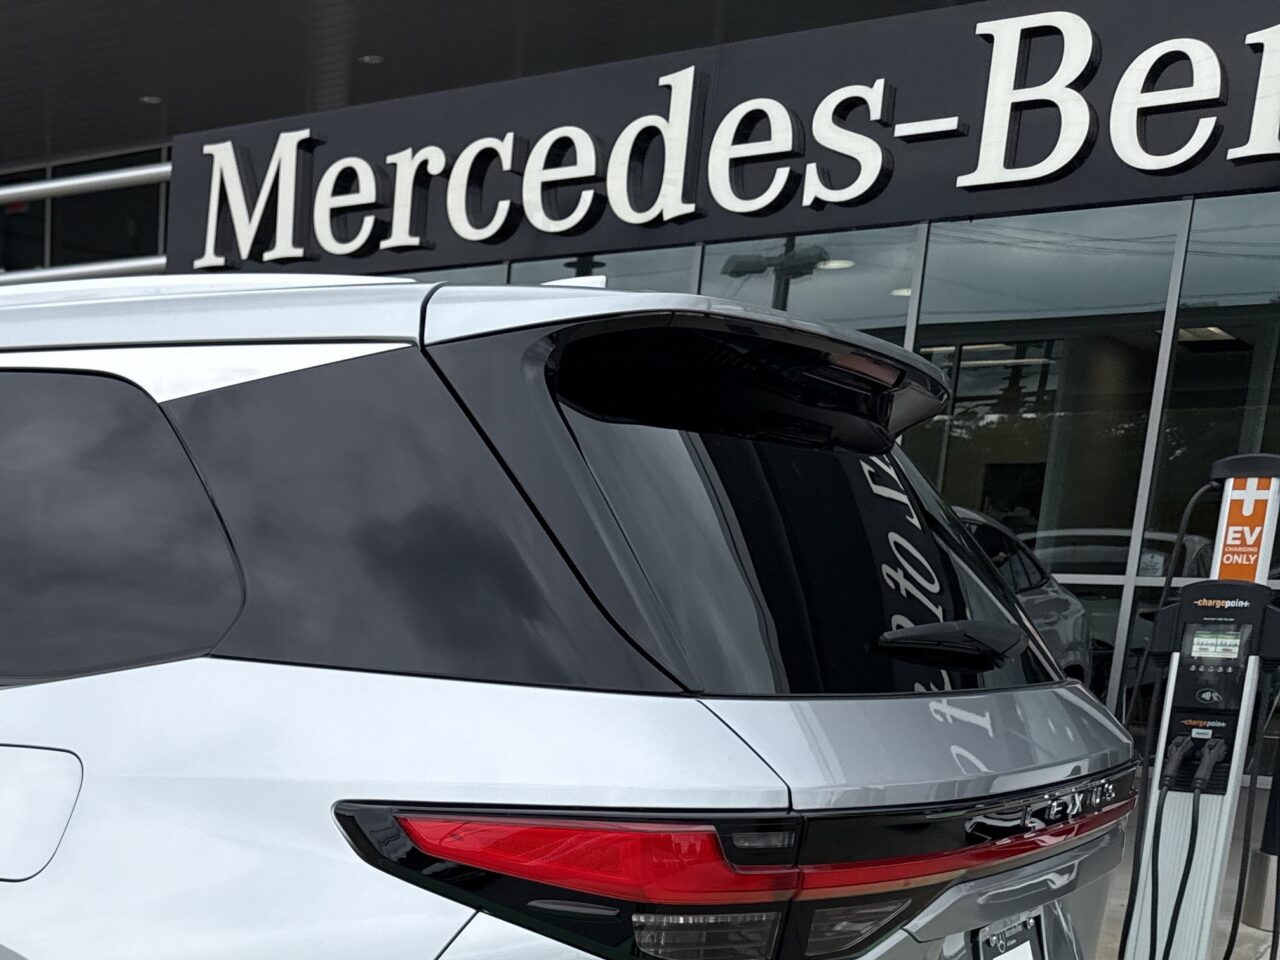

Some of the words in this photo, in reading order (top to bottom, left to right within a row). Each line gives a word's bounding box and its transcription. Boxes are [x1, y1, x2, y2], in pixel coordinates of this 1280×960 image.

[1226, 526, 1262, 545] EV
[1223, 554, 1258, 564] ONLY
[1024, 783, 1115, 828] LEXUS
